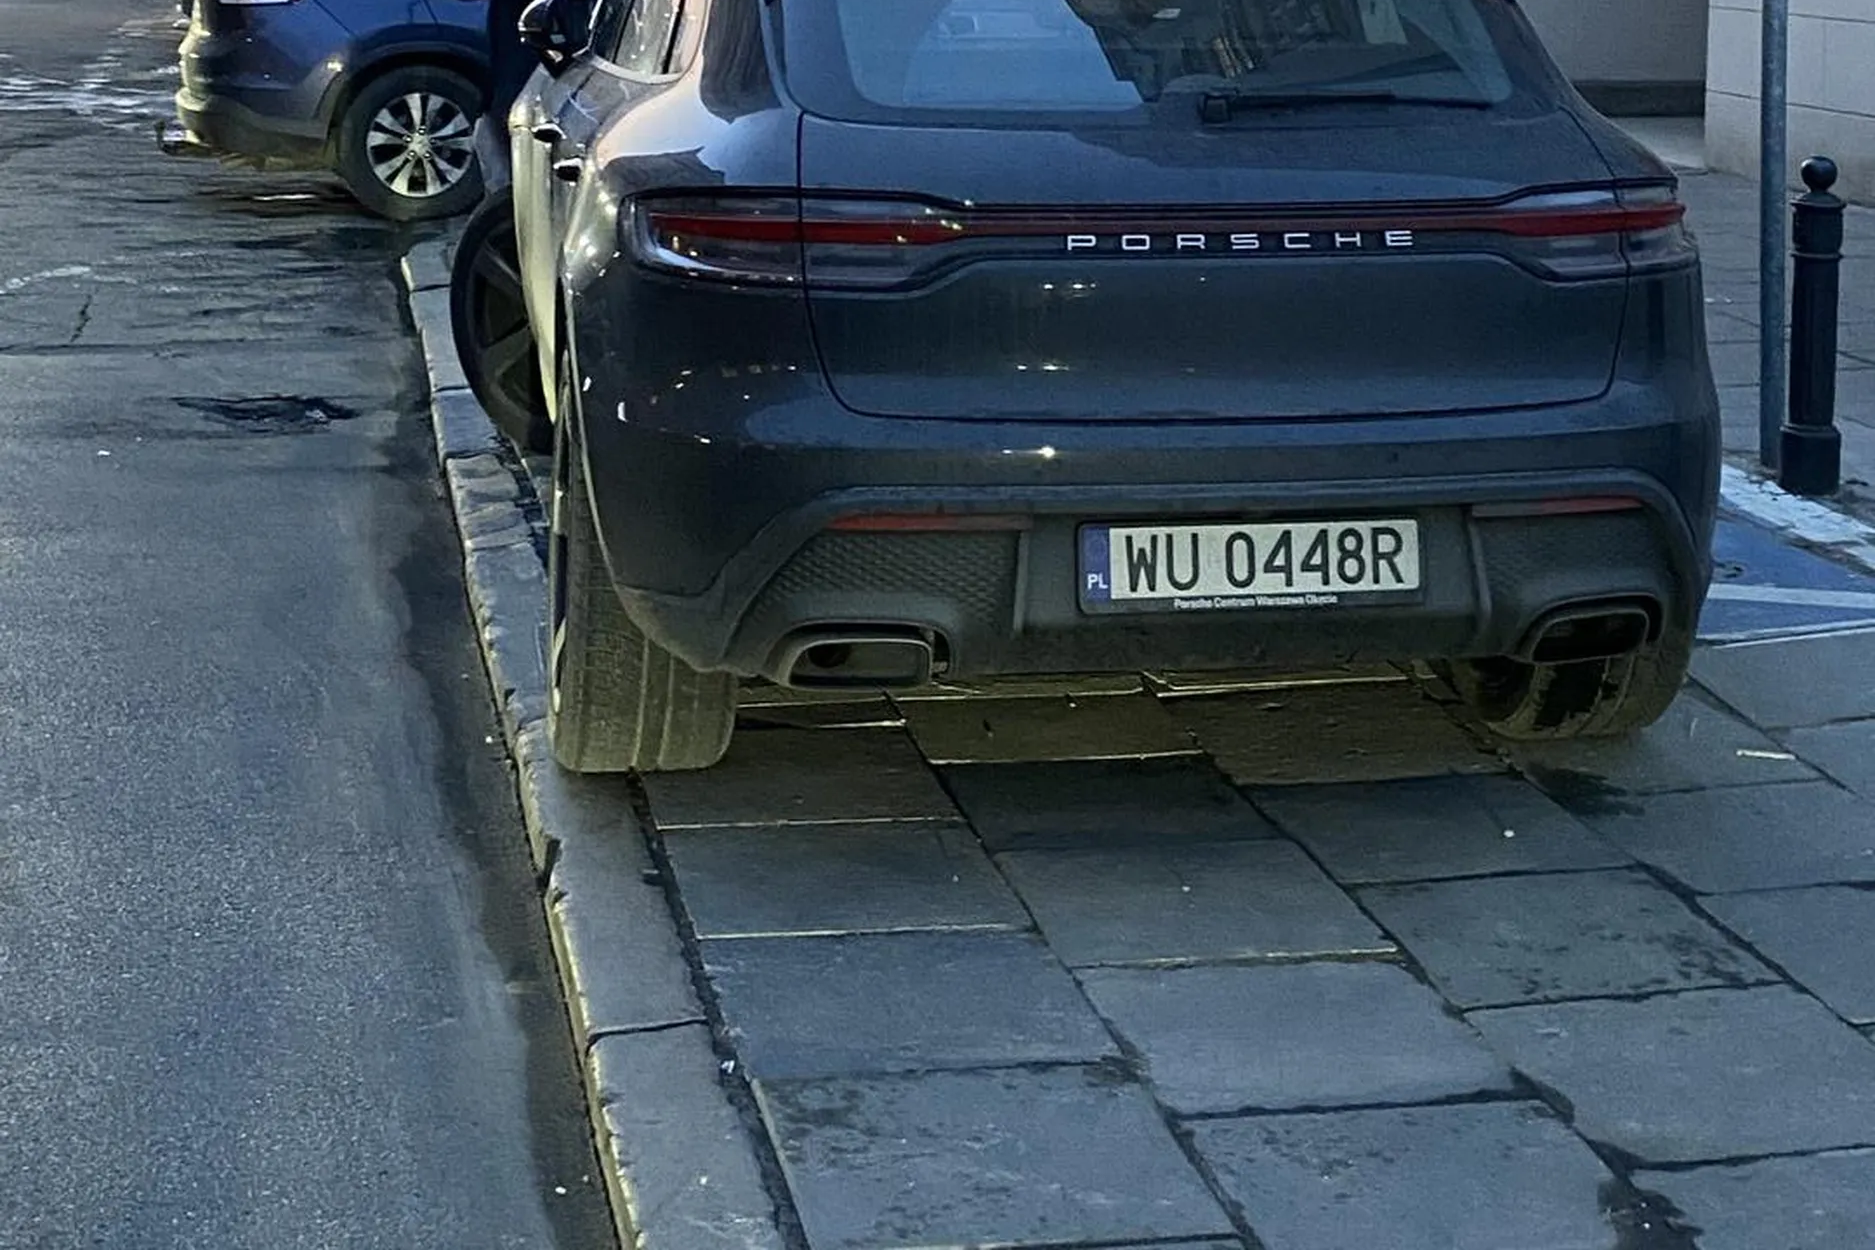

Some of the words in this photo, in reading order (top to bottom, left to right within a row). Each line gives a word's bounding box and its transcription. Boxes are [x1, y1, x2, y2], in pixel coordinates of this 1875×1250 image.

[1066, 229, 1414, 251] PORSCHE
[1124, 531, 1200, 593] WU
[1225, 526, 1405, 589] 0448R
[1086, 573, 1109, 590] PL
